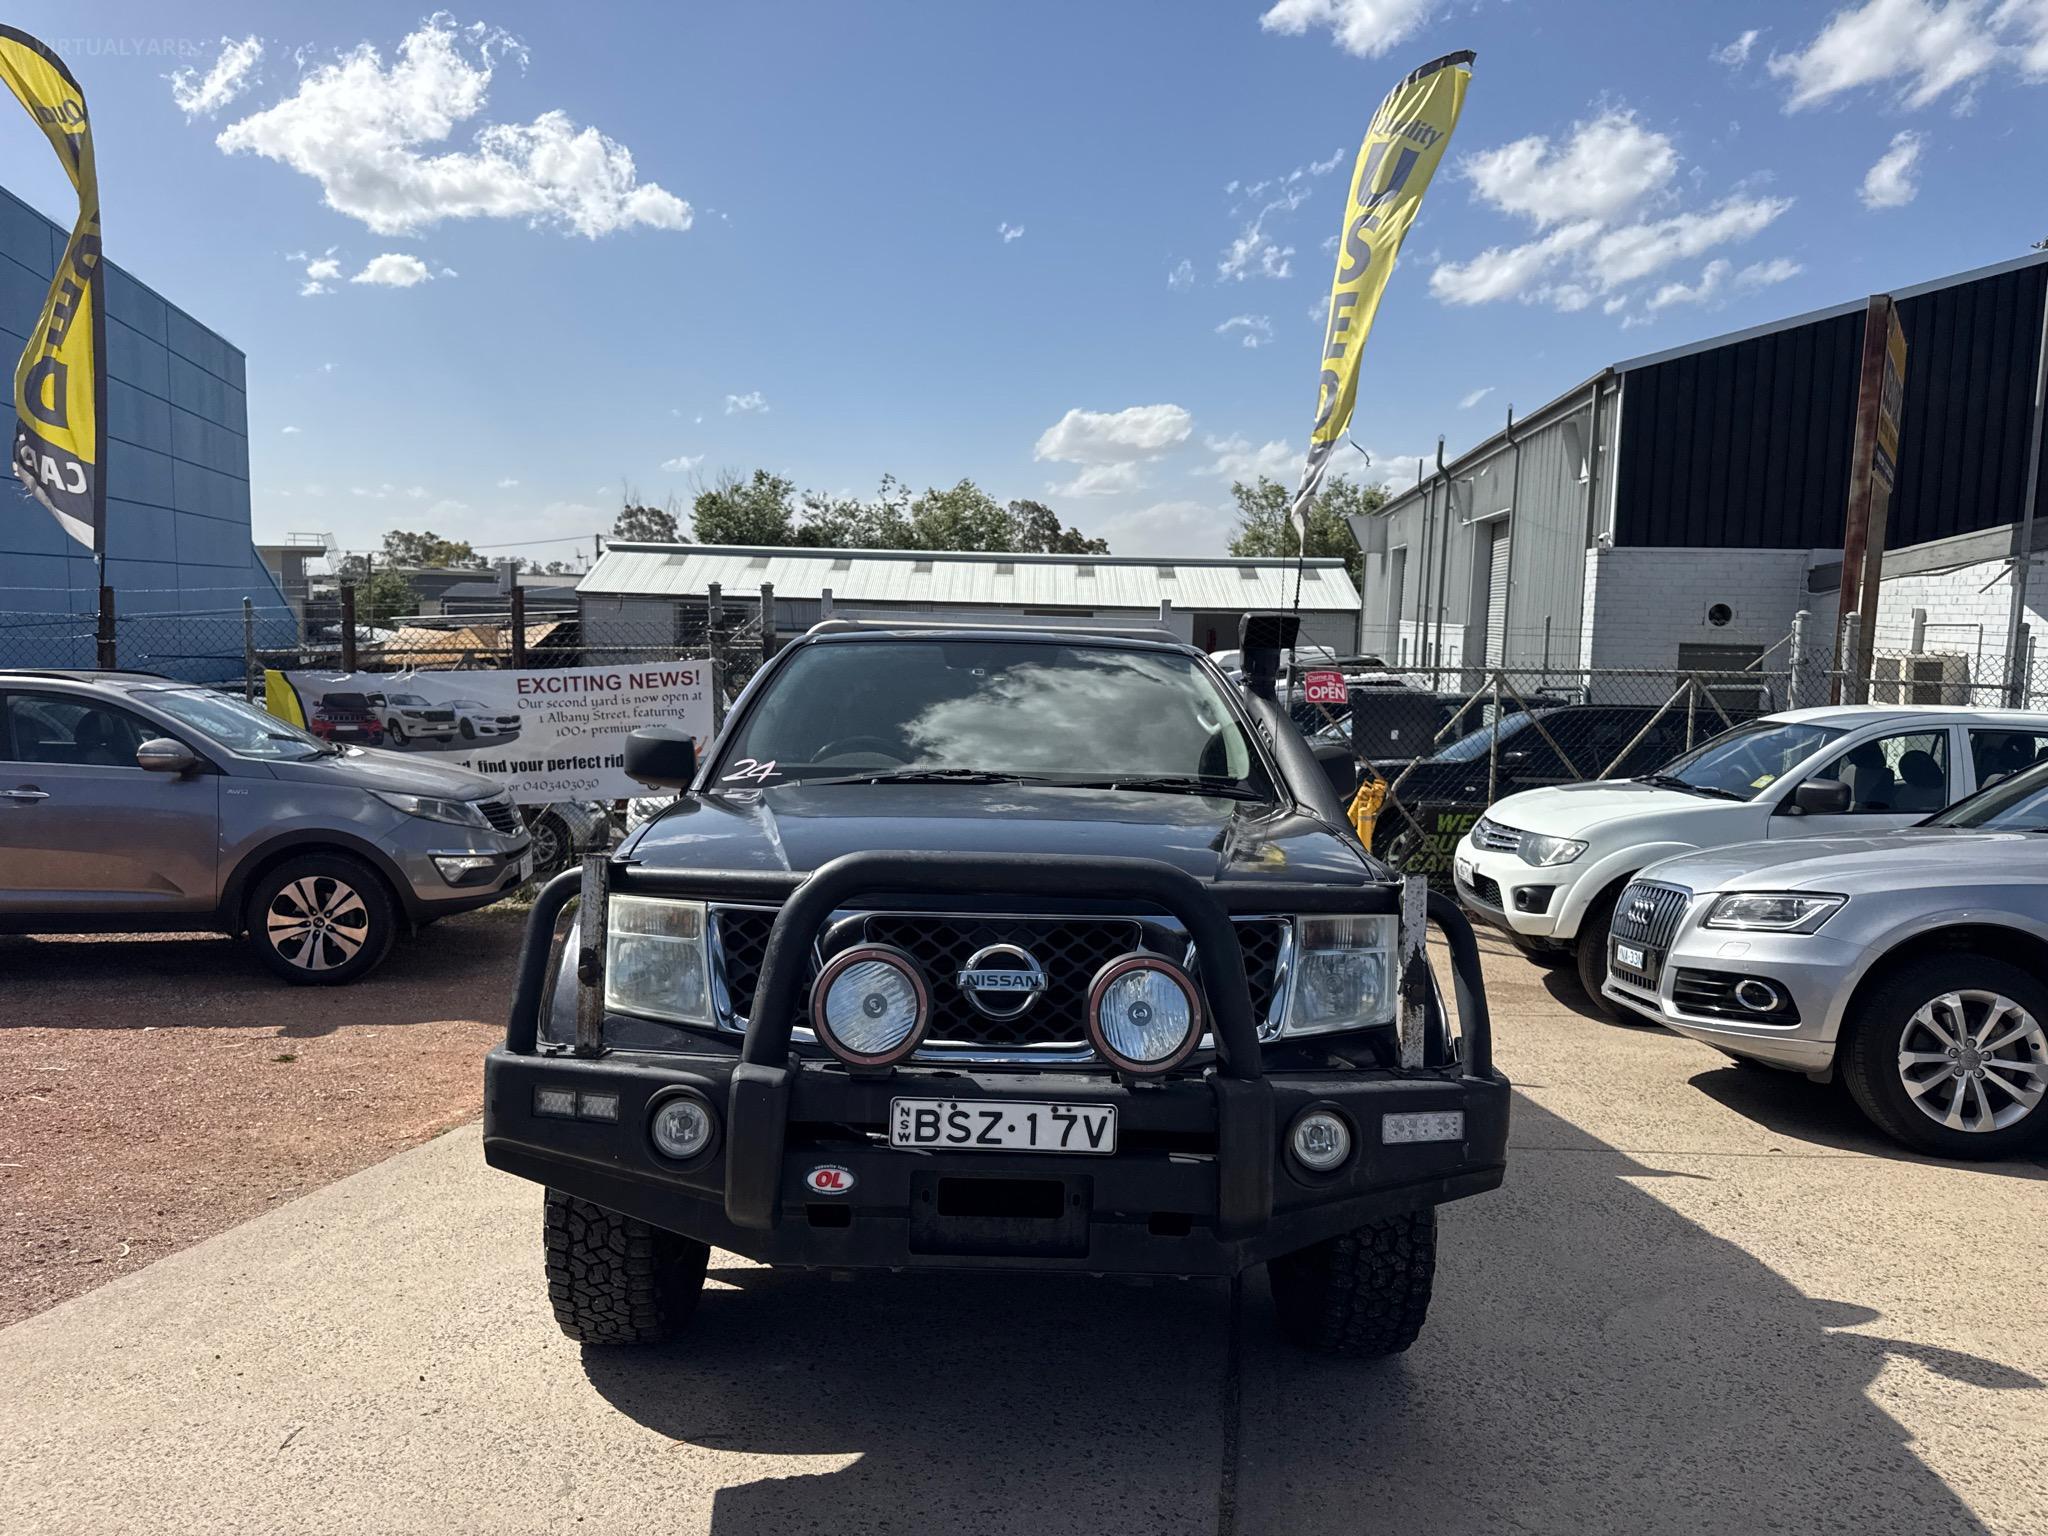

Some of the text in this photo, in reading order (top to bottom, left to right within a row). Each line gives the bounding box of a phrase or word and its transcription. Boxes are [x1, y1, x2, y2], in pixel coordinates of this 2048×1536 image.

[517, 670, 701, 695] EXCITING NEWS!
[1308, 685, 1346, 700] OPEN
[517, 691, 702, 711] Our second yard is now open at
[547, 711, 590, 725] Albany
[633, 705, 685, 719] featuring
[477, 759, 507, 773] find
[510, 760, 544, 774] your
[549, 756, 601, 772] perfect
[605, 754, 625, 768] rid
[721, 758, 783, 783] 24
[508, 784, 520, 792] or
[523, 778, 599, 792] 0403403030
[966, 974, 1039, 988] NISSAN
[815, 1171, 845, 1188] OL
